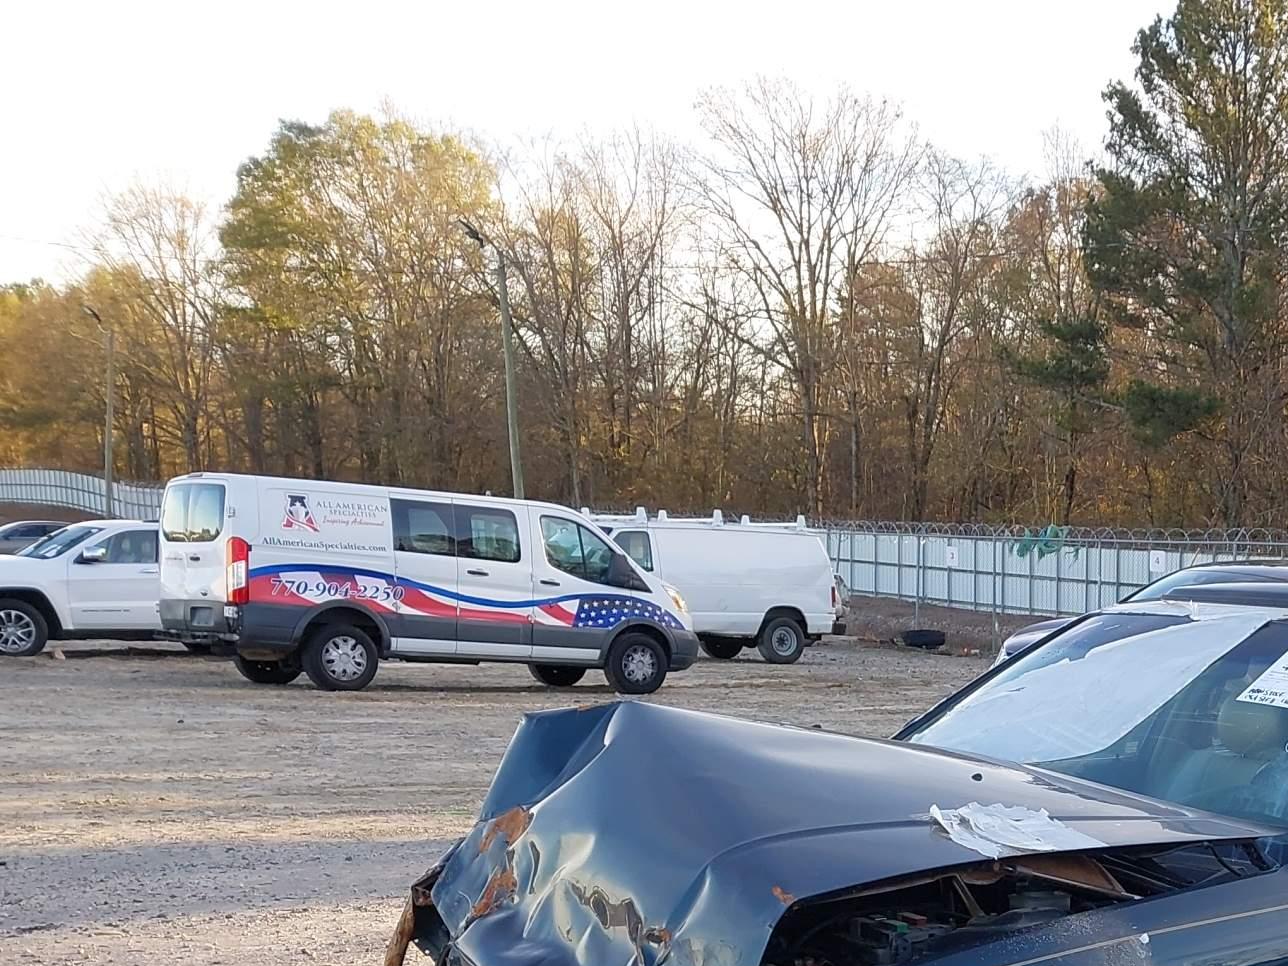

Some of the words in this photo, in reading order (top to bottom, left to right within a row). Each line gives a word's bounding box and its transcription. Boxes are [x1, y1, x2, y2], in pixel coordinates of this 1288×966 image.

[316, 500, 335, 509] ALL
[336, 502, 387, 513] AMERICAN
[329, 509, 376, 518] SPECIALTIES
[262, 537, 387, 552] AllAmericanSpecialties.com
[271, 578, 404, 601] 770-904-2250
